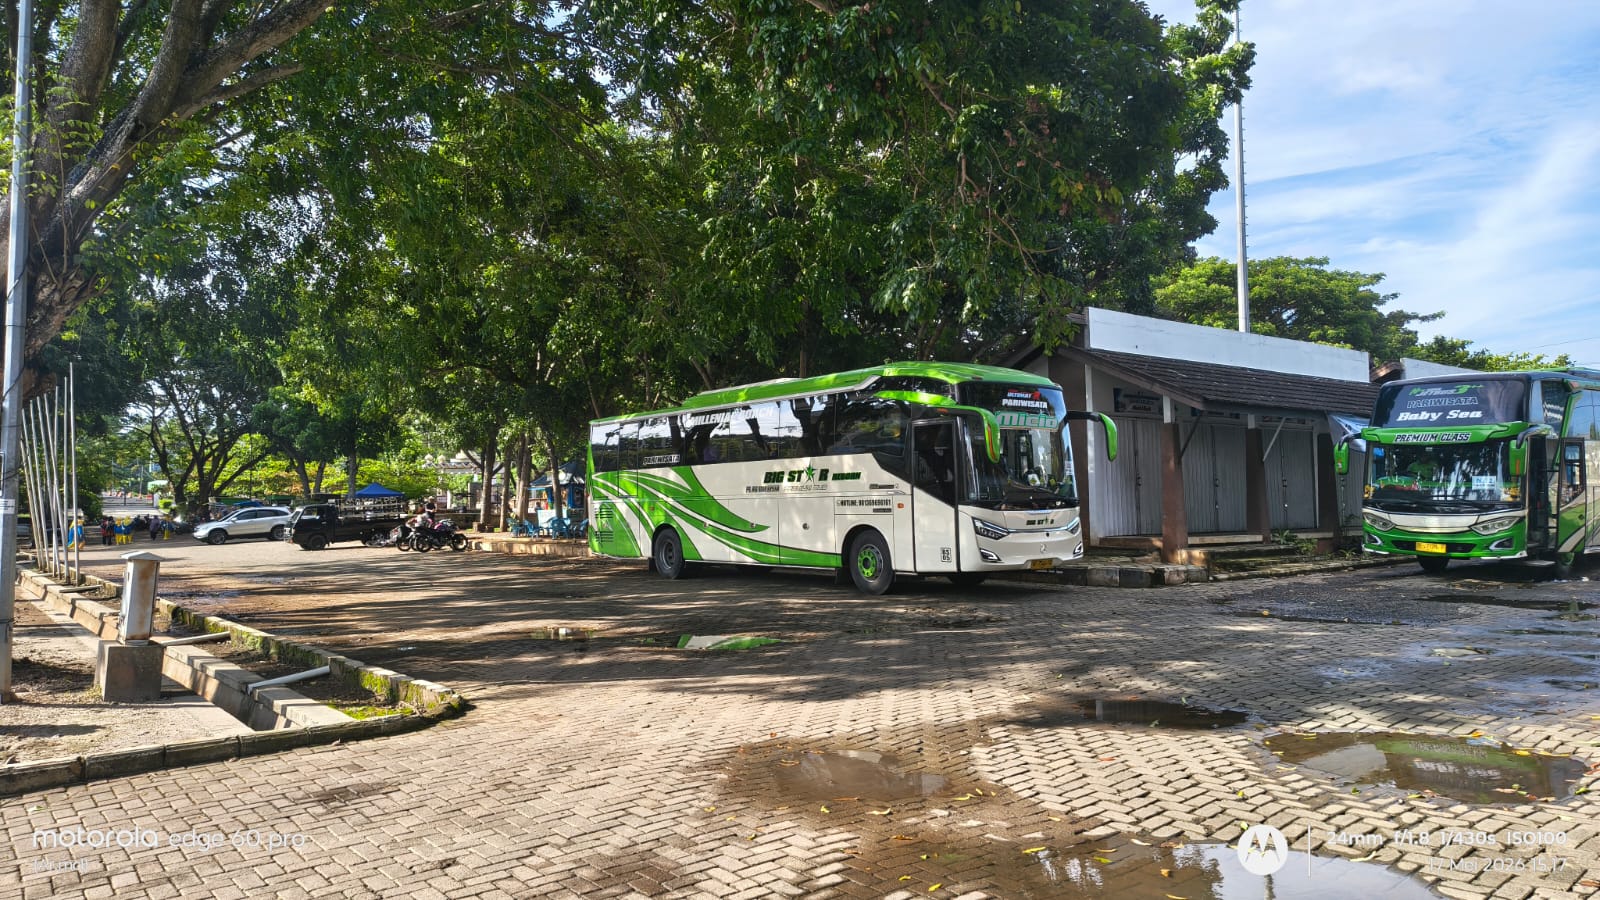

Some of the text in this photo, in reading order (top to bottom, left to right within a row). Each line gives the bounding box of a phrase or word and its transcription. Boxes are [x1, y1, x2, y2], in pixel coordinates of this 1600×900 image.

[1002, 398, 1048, 409] PARIWISATA
[1407, 396, 1479, 409] PARIWISATA
[1396, 409, 1483, 421] Baby Sea
[1394, 432, 1471, 443] PREMIUM CLASS
[763, 470, 785, 484] BIG
